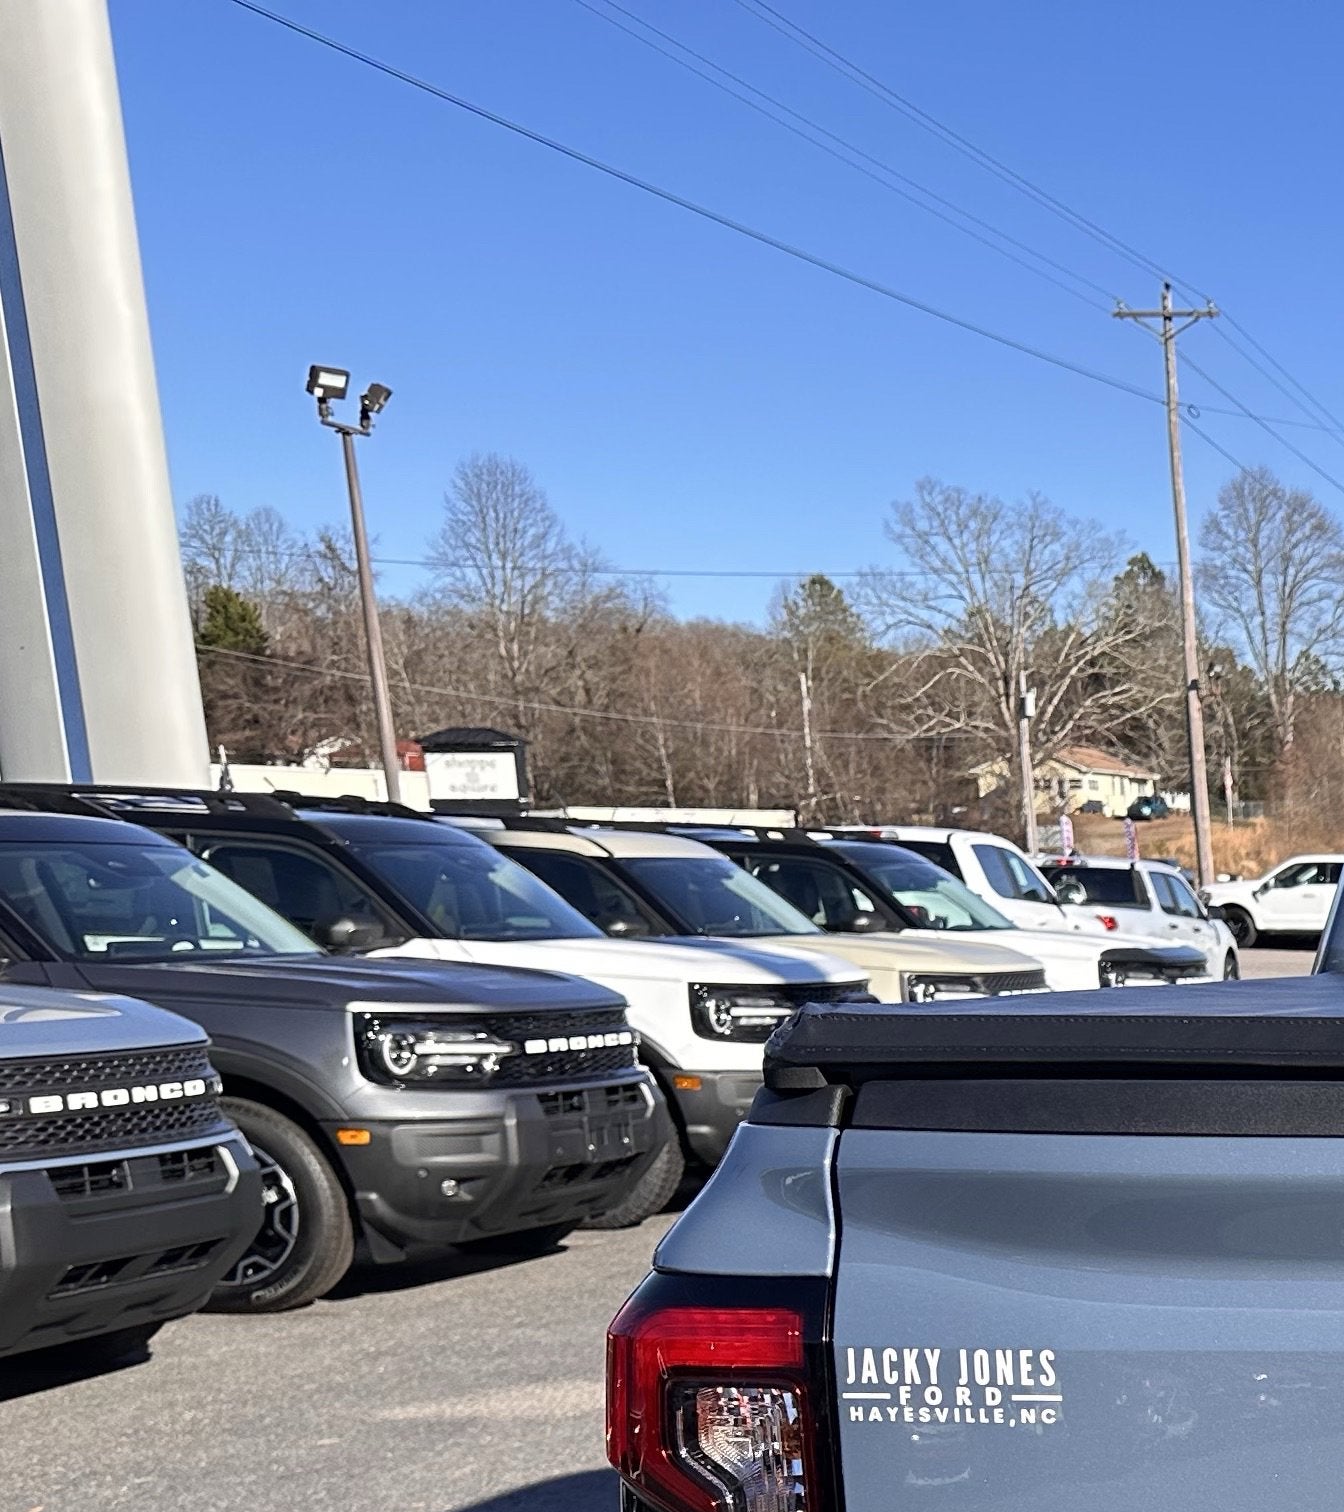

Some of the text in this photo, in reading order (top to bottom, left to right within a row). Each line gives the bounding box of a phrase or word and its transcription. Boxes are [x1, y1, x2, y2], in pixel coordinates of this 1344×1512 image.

[28, 1078, 206, 1114] BRONCO
[846, 1347, 1057, 1387] JACKY JONES
[899, 1386, 1003, 1407] FORD
